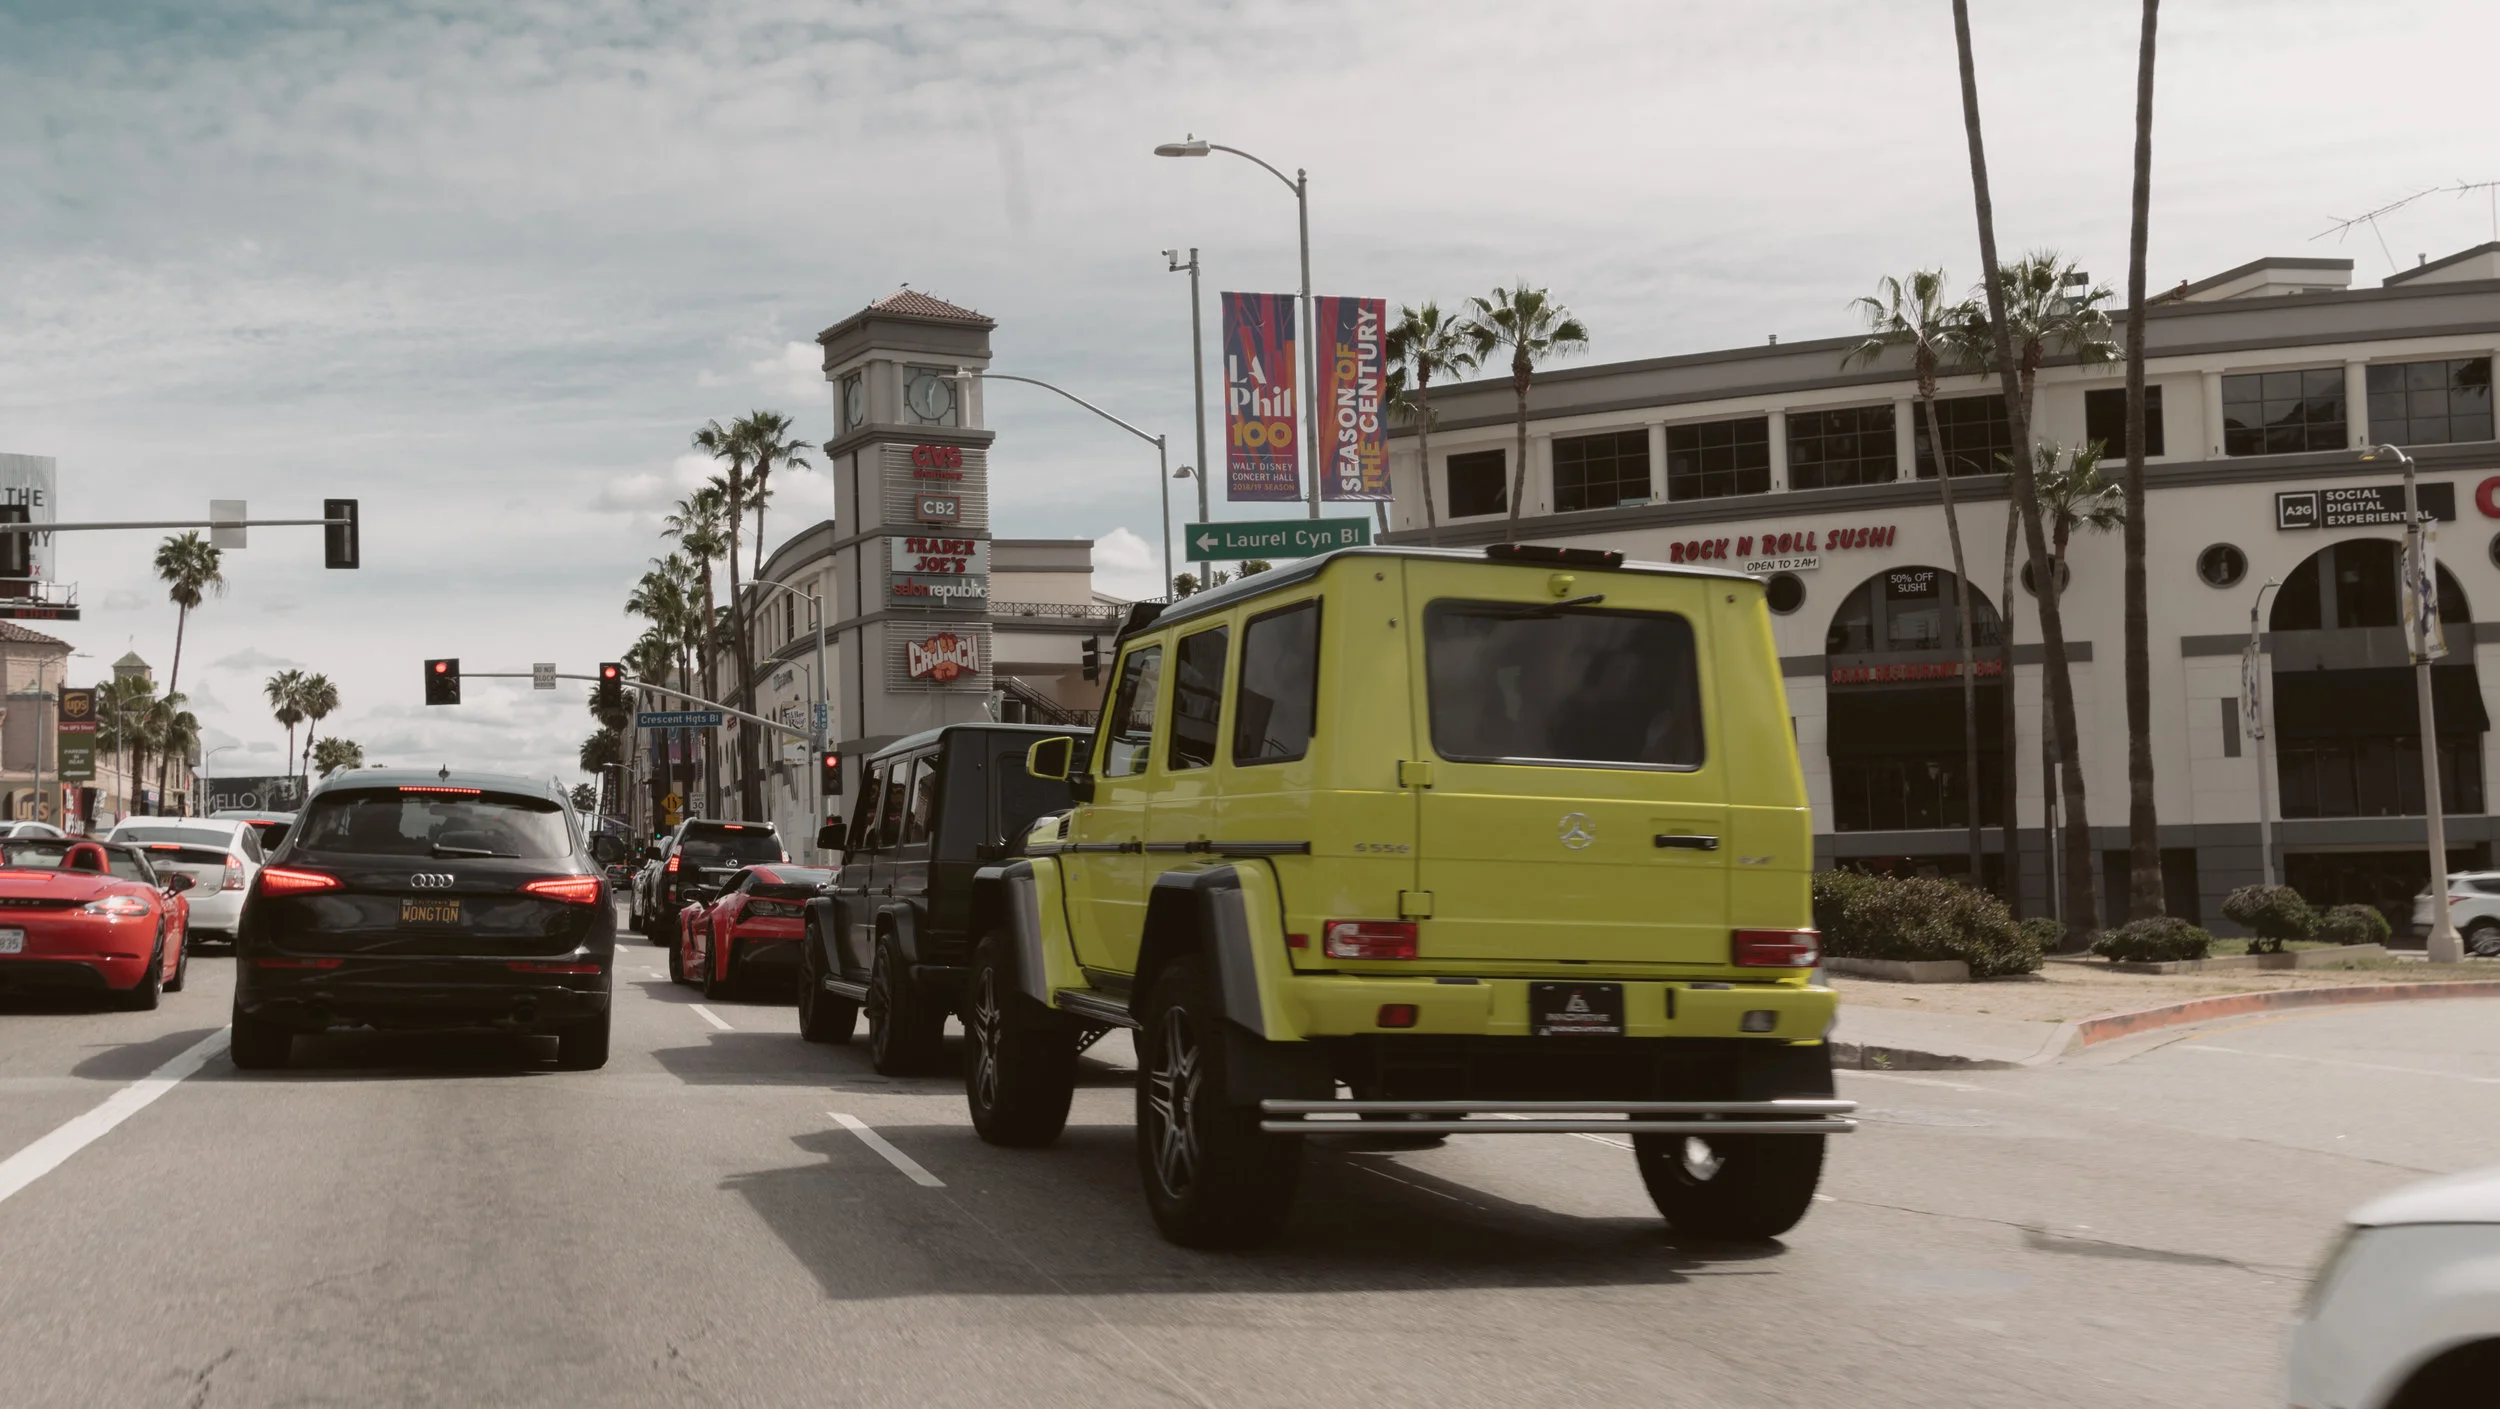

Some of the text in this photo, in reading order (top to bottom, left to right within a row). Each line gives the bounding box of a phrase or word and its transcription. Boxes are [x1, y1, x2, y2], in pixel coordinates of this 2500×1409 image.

[1229, 354, 1267, 384] LA
[1230, 386, 1291, 417] Phil
[1357, 308, 1384, 493] THE CENTURY
[1336, 342, 1361, 492] SEASON OF
[1232, 421, 1292, 448] 100
[912, 445, 963, 468] CVS
[1232, 462, 1293, 472] WALT DISNEY
[1232, 472, 1294, 482] CONCERT HALL
[1232, 482, 1295, 491] 2018/19 SEASON
[5, 487, 44, 507] THE
[2326, 489, 2380, 501] SOCIAL
[923, 501, 955, 515] CB2
[2285, 505, 2312, 516] A2G
[2326, 501, 2385, 513] DIGITAL
[2327, 510, 2433, 525] EXPERIENTAL
[1226, 528, 1359, 548] Laurel Cyn Bl
[1670, 525, 1897, 563] ROCK N ROLL SUSHI
[905, 537, 976, 555] TRADER
[914, 556, 967, 573] JOE'S
[1747, 560, 1775, 572] OPEN
[1778, 559, 1792, 570] TO
[1891, 572, 1934, 584] 50% OFF
[1898, 583, 1927, 593] SUSHI
[907, 633, 980, 677] CRUNCH
[1832, 666, 1871, 684] ASIAN
[1875, 661, 1957, 682] RESTAURANT
[1976, 659, 2003, 677] BAR
[67, 700, 87, 714] ups
[641, 714, 719, 725] Crescent Hgts Bl
[693, 801, 704, 809] 30
[402, 906, 459, 921] WONGTON
